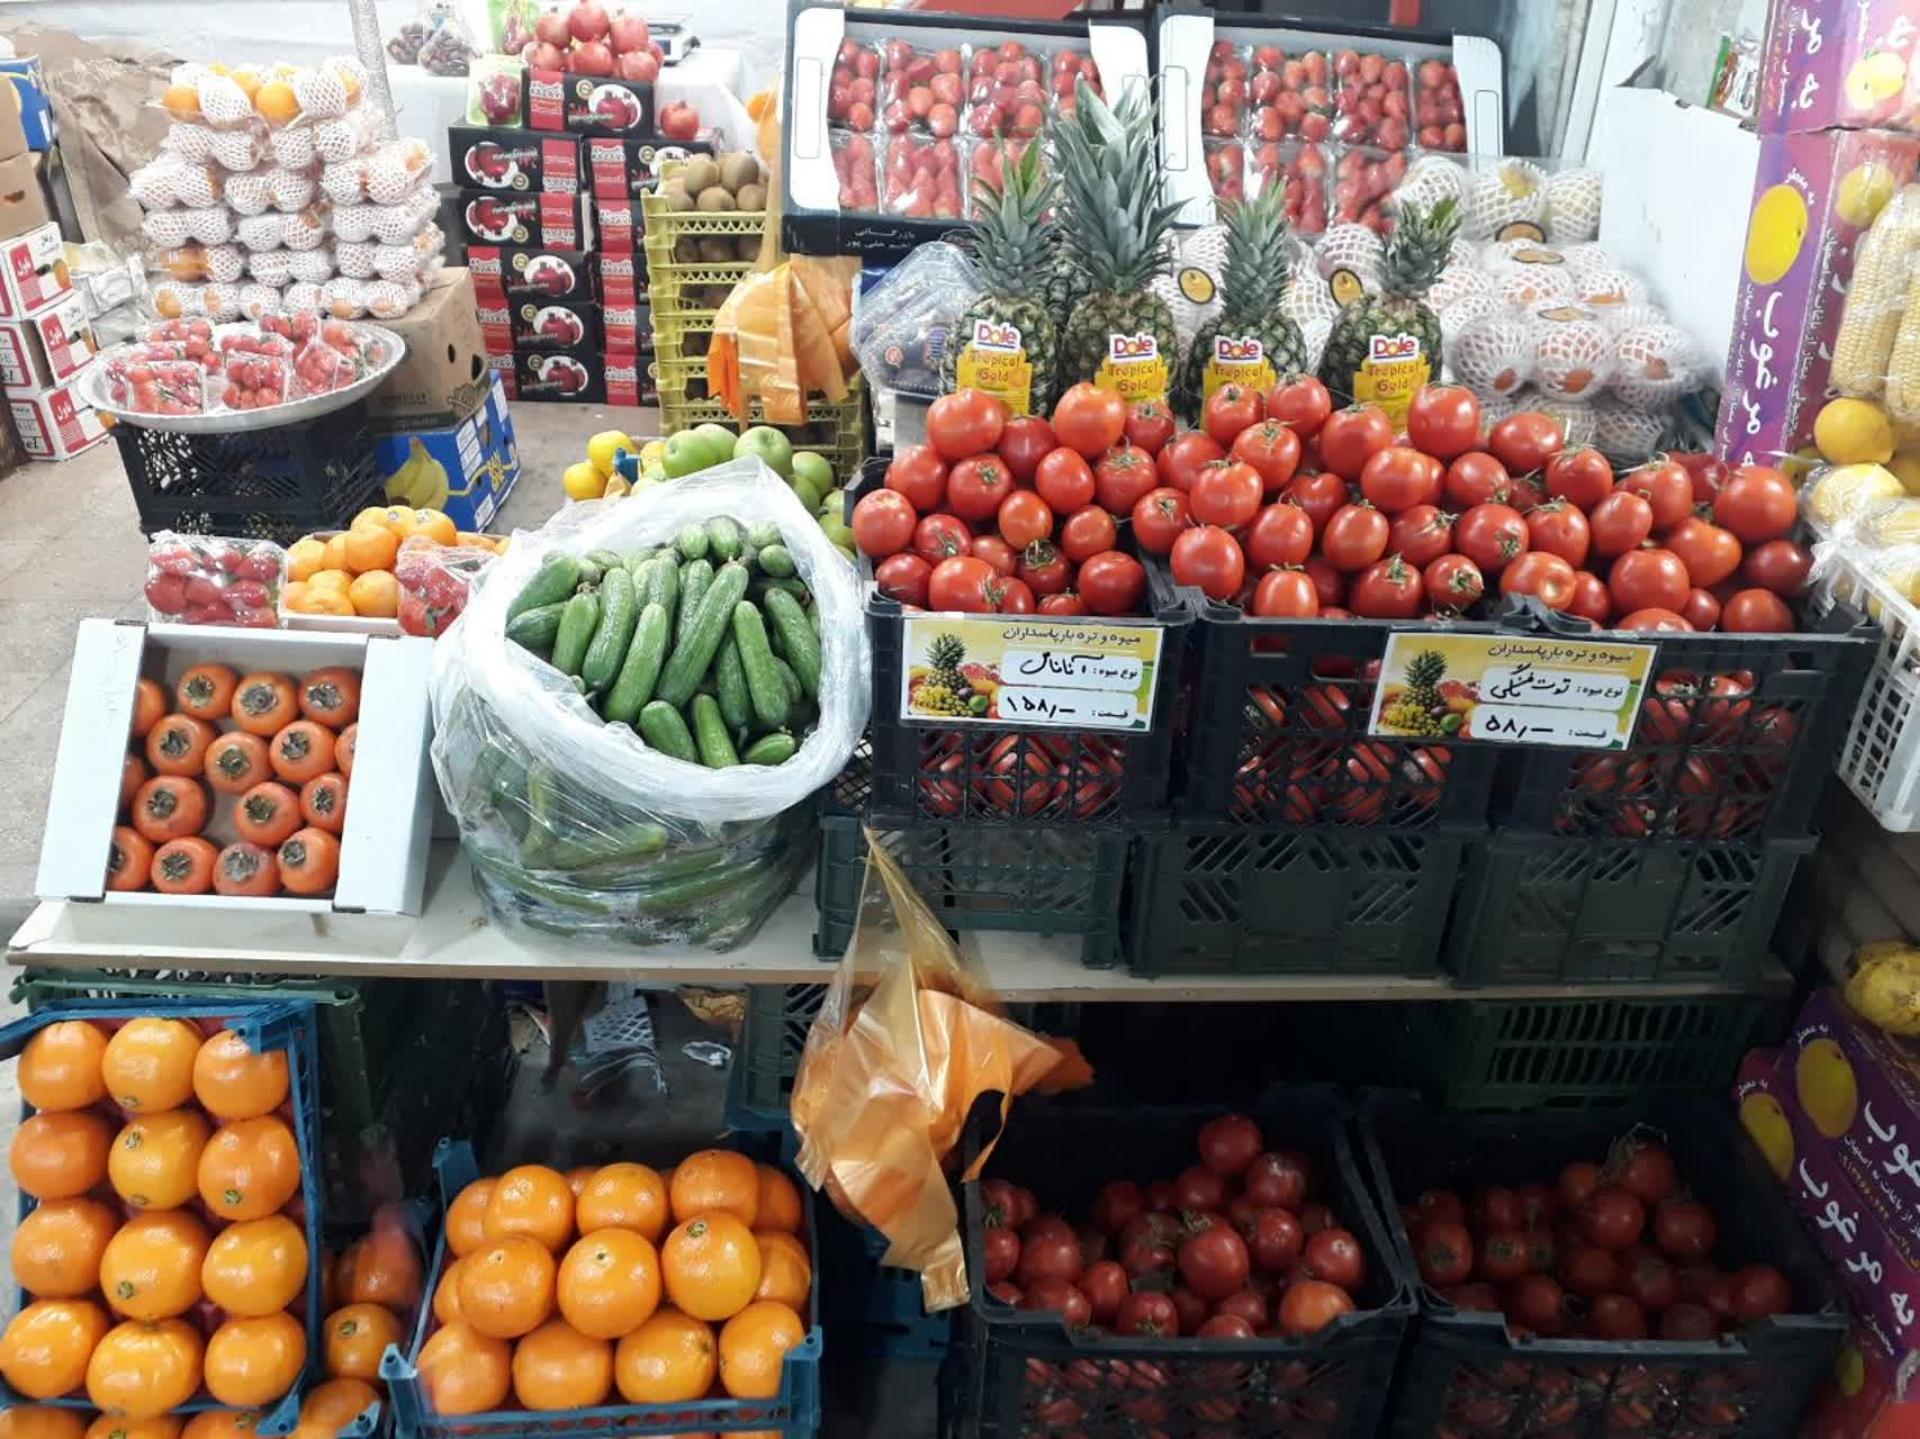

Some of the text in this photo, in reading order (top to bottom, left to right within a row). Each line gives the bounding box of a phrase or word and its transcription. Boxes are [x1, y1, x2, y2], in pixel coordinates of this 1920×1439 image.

[978, 323, 1017, 345] Dole
[1114, 335, 1153, 354] Dole
[1219, 339, 1260, 357] Dole
[1373, 336, 1415, 355] Dole
[969, 350, 1020, 369] Tropical
[1742, 291, 1782, 434] مرغوب
[977, 367, 1009, 382] Gold
[1107, 361, 1158, 378] Tropical
[1215, 364, 1263, 379] Tropical
[1366, 362, 1419, 377] Tropical
[1116, 379, 1149, 392] Gold
[1377, 378, 1409, 392] Gold
[1002, 626, 1141, 646] میوه و تره بار پاسداران
[1488, 641, 1632, 663] میوه و تره بار پاسداران
[1120, 669, 1138, 680] نوع
[1531, 678, 1571, 695] توت
[1604, 686, 1623, 698] نوع
[1799, 1157, 1882, 1284] مرغوب
[1890, 1293, 1915, 1336] به
